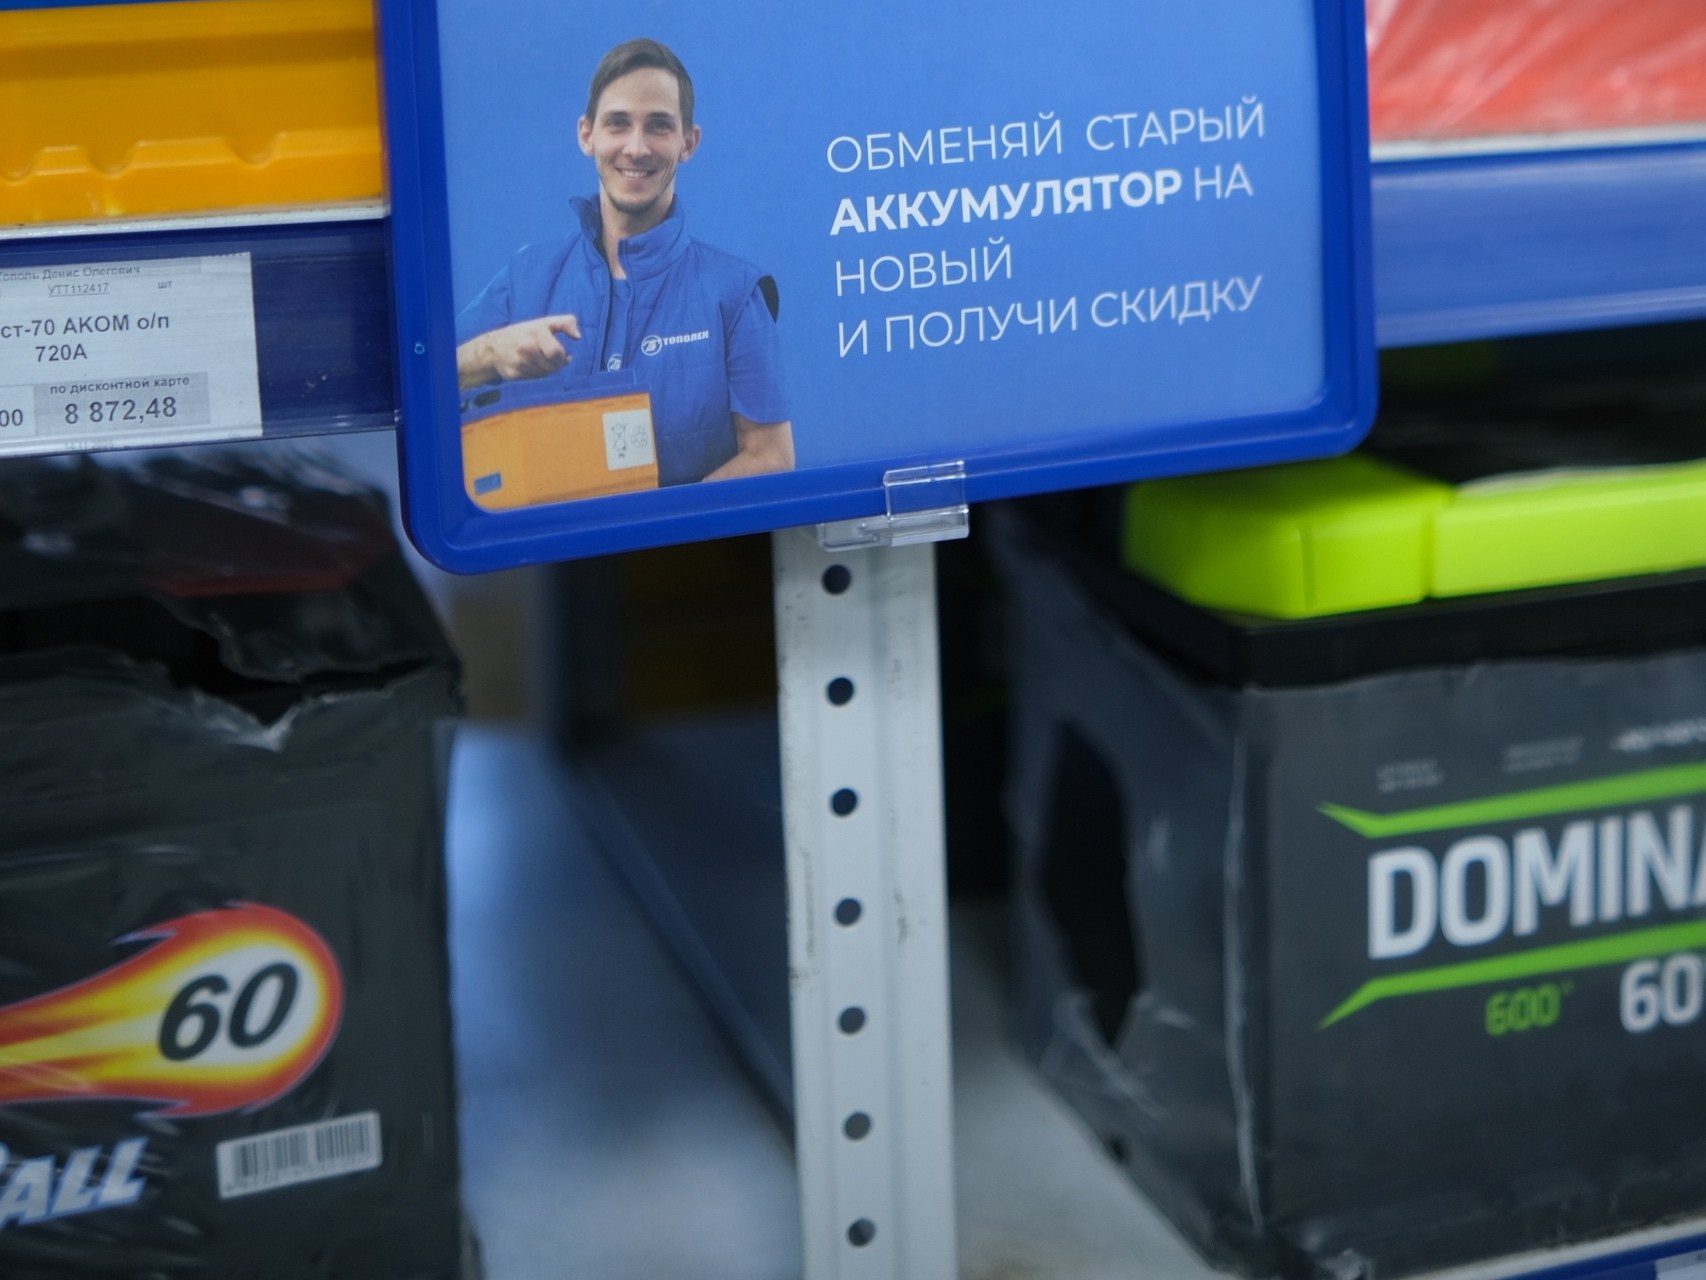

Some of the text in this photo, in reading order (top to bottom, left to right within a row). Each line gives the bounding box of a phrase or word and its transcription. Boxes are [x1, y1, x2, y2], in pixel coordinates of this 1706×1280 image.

[826, 95, 1265, 173] ОБМЕНЯЙ СТАРЫЙ
[830, 163, 1254, 236] АККУМУЛЯТОР НА
[835, 236, 1012, 297] НОВЫЙ
[63, 314, 130, 335] АКОМ
[137, 312, 170, 330] о/п
[662, 330, 710, 346] ТОПОЛЕК
[838, 275, 1263, 358] И ПОЛУЧИ СКИДКУ
[35, 344, 88, 363] 720А
[50, 376, 190, 395] по дисконтной карте
[64, 396, 177, 424] 8 872,48
[1367, 803, 1706, 961] DOMIN
[158, 961, 299, 1061] 60
[1485, 983, 1561, 1037] 600
[1619, 951, 1705, 1035] 60
